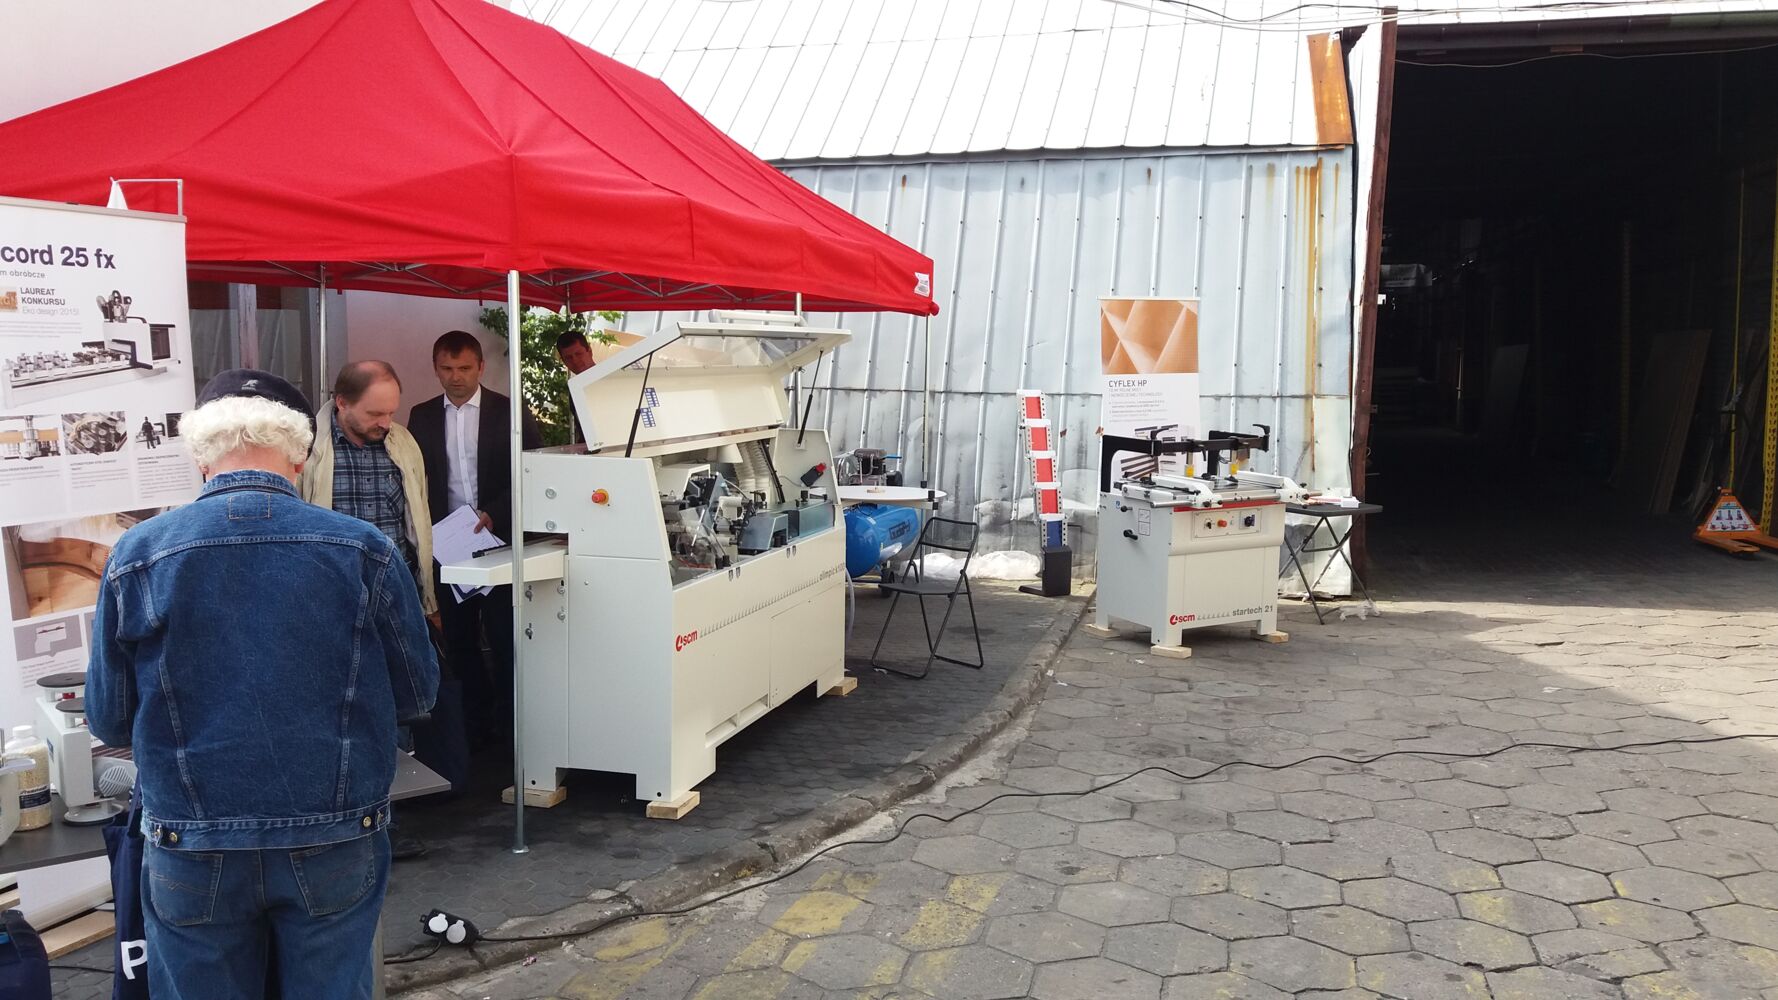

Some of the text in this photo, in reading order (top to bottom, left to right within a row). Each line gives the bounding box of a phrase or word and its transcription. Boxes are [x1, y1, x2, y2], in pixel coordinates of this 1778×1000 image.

[60, 246, 89, 267] 25
[94, 248, 116, 269] fx
[20, 287, 55, 296] LAUREAT
[21, 297, 66, 306] KONKURSU
[1178, 605, 1273, 623] scm startech 21
[683, 631, 698, 646] scm
